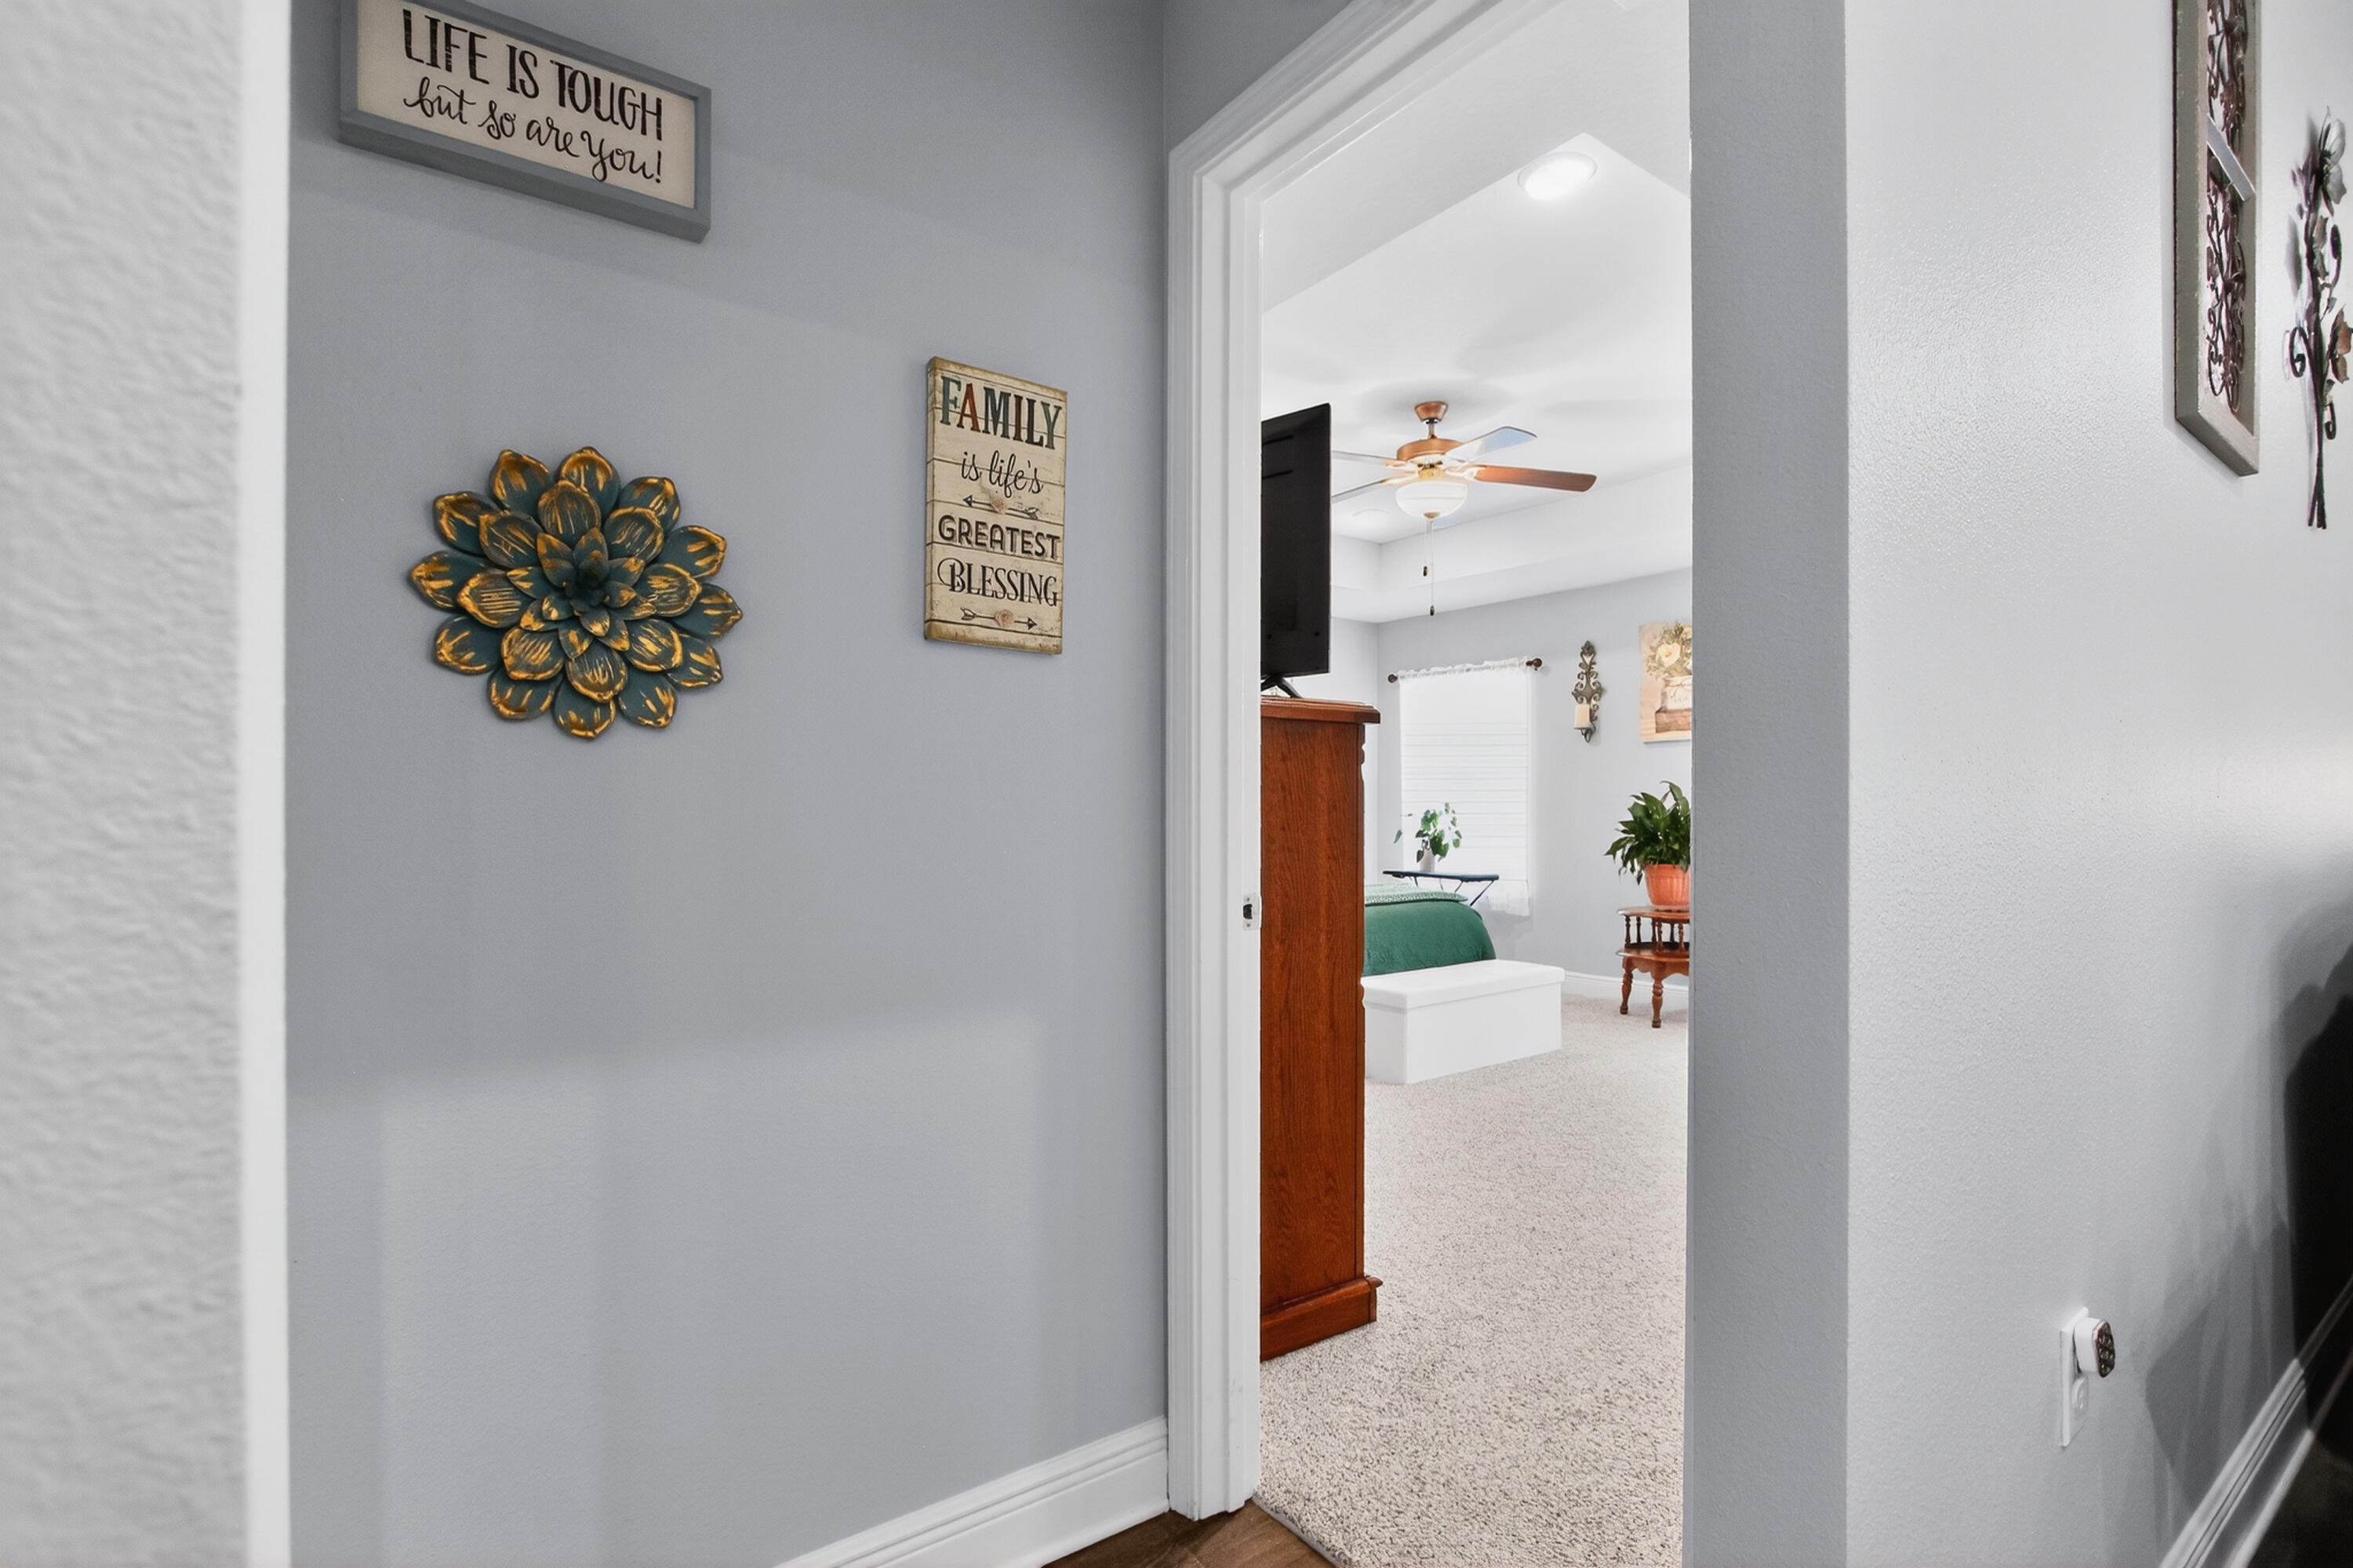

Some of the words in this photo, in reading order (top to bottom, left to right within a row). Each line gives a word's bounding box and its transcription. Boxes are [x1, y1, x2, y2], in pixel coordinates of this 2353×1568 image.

[402, 8, 490, 85] LIFE
[507, 43, 539, 99] IS
[551, 59, 663, 141] TOUGH
[403, 77, 476, 125] but
[526, 117, 580, 158] are
[940, 375, 1062, 449] FAMILY
[961, 451, 982, 481] is
[988, 450, 1044, 498] life's
[939, 515, 1060, 559] GREATEST
[937, 558, 1057, 607] BLESSING
